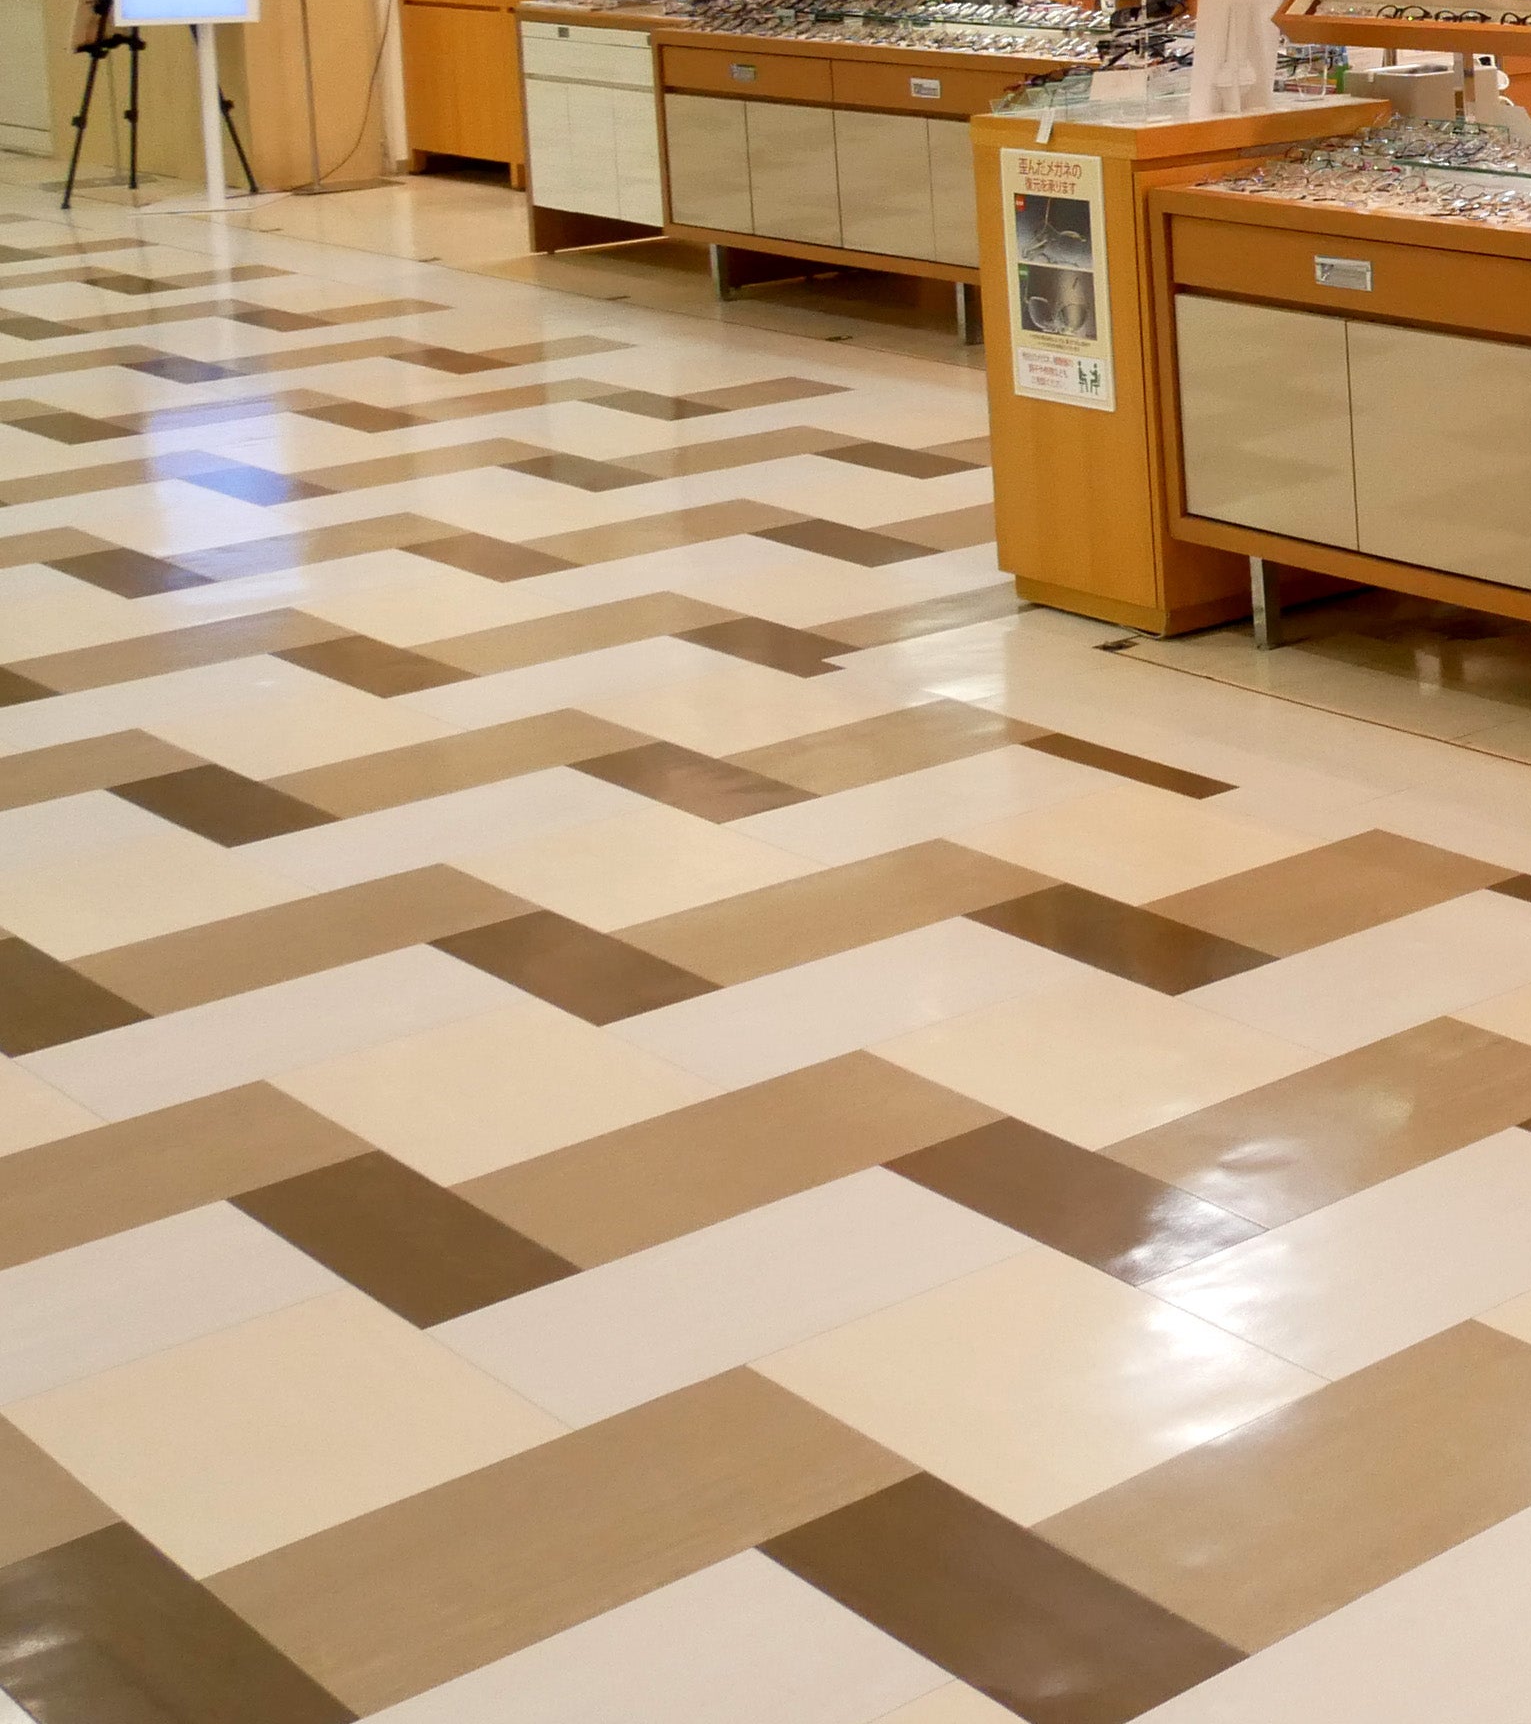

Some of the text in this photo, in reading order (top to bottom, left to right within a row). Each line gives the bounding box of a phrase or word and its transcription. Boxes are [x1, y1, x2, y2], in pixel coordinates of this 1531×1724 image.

[1018, 157, 1082, 179] 歪んだメガネの
